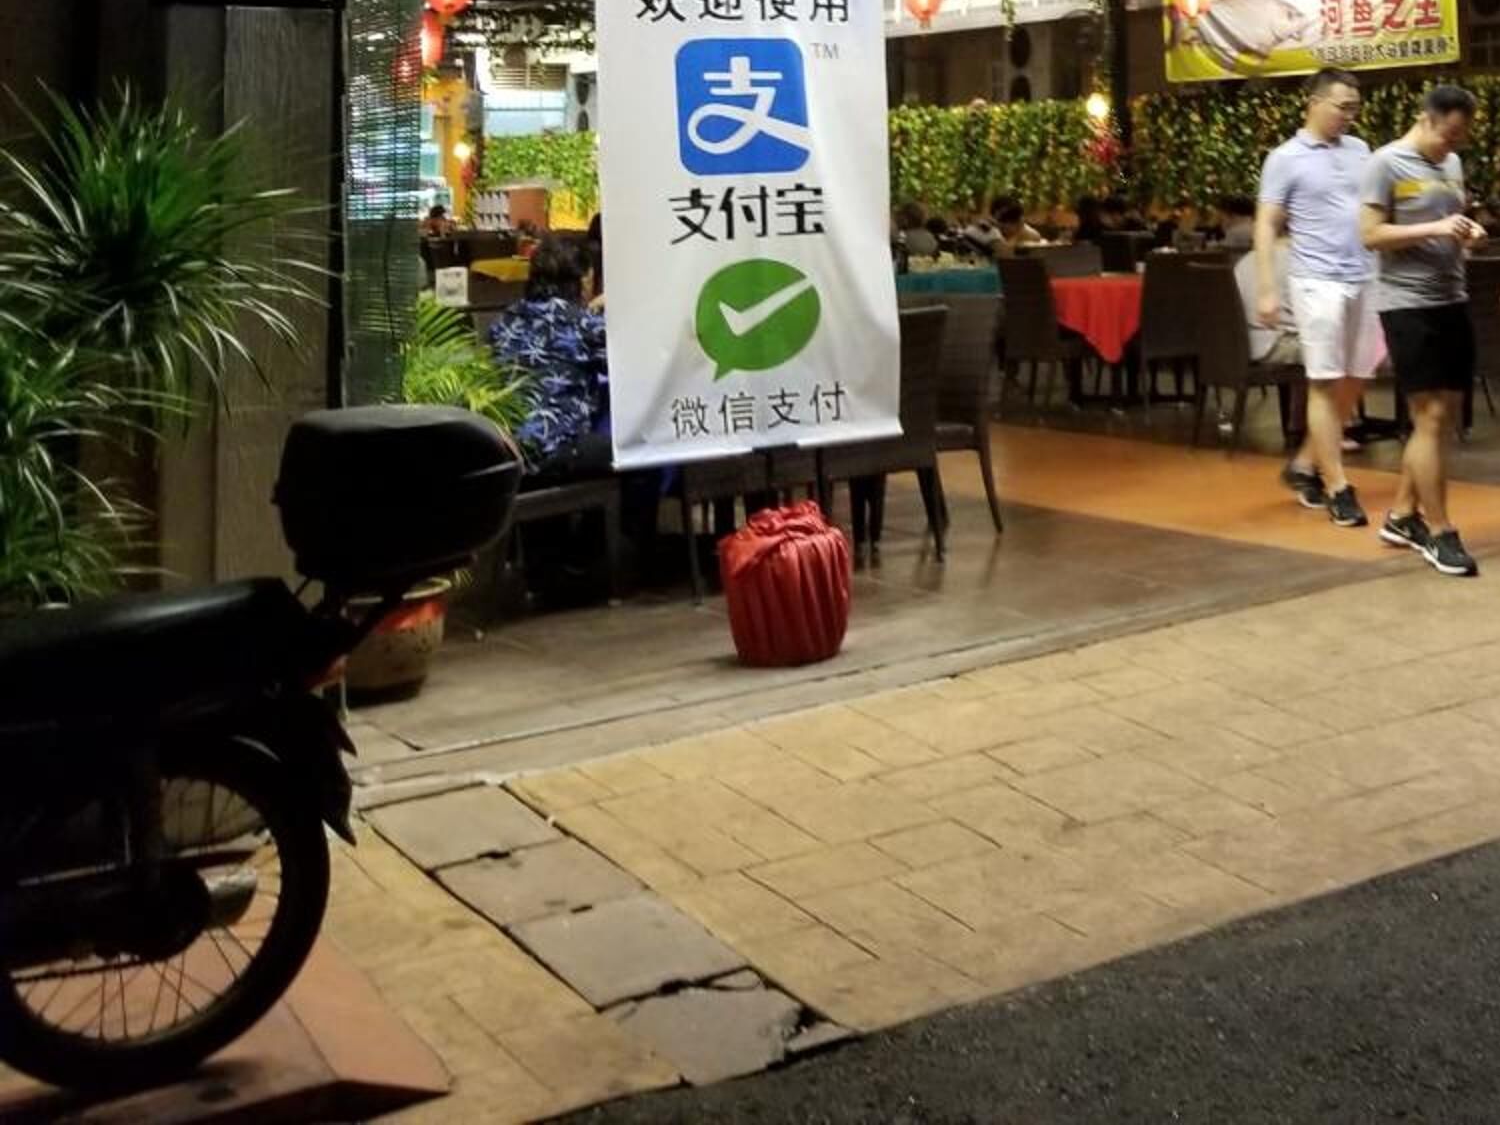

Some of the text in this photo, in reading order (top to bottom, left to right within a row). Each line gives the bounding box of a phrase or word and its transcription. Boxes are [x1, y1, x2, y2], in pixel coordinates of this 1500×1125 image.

[810, 42, 840, 60] TM
[669, 184, 826, 243] 支付宝
[671, 382, 848, 440] 微信支付
